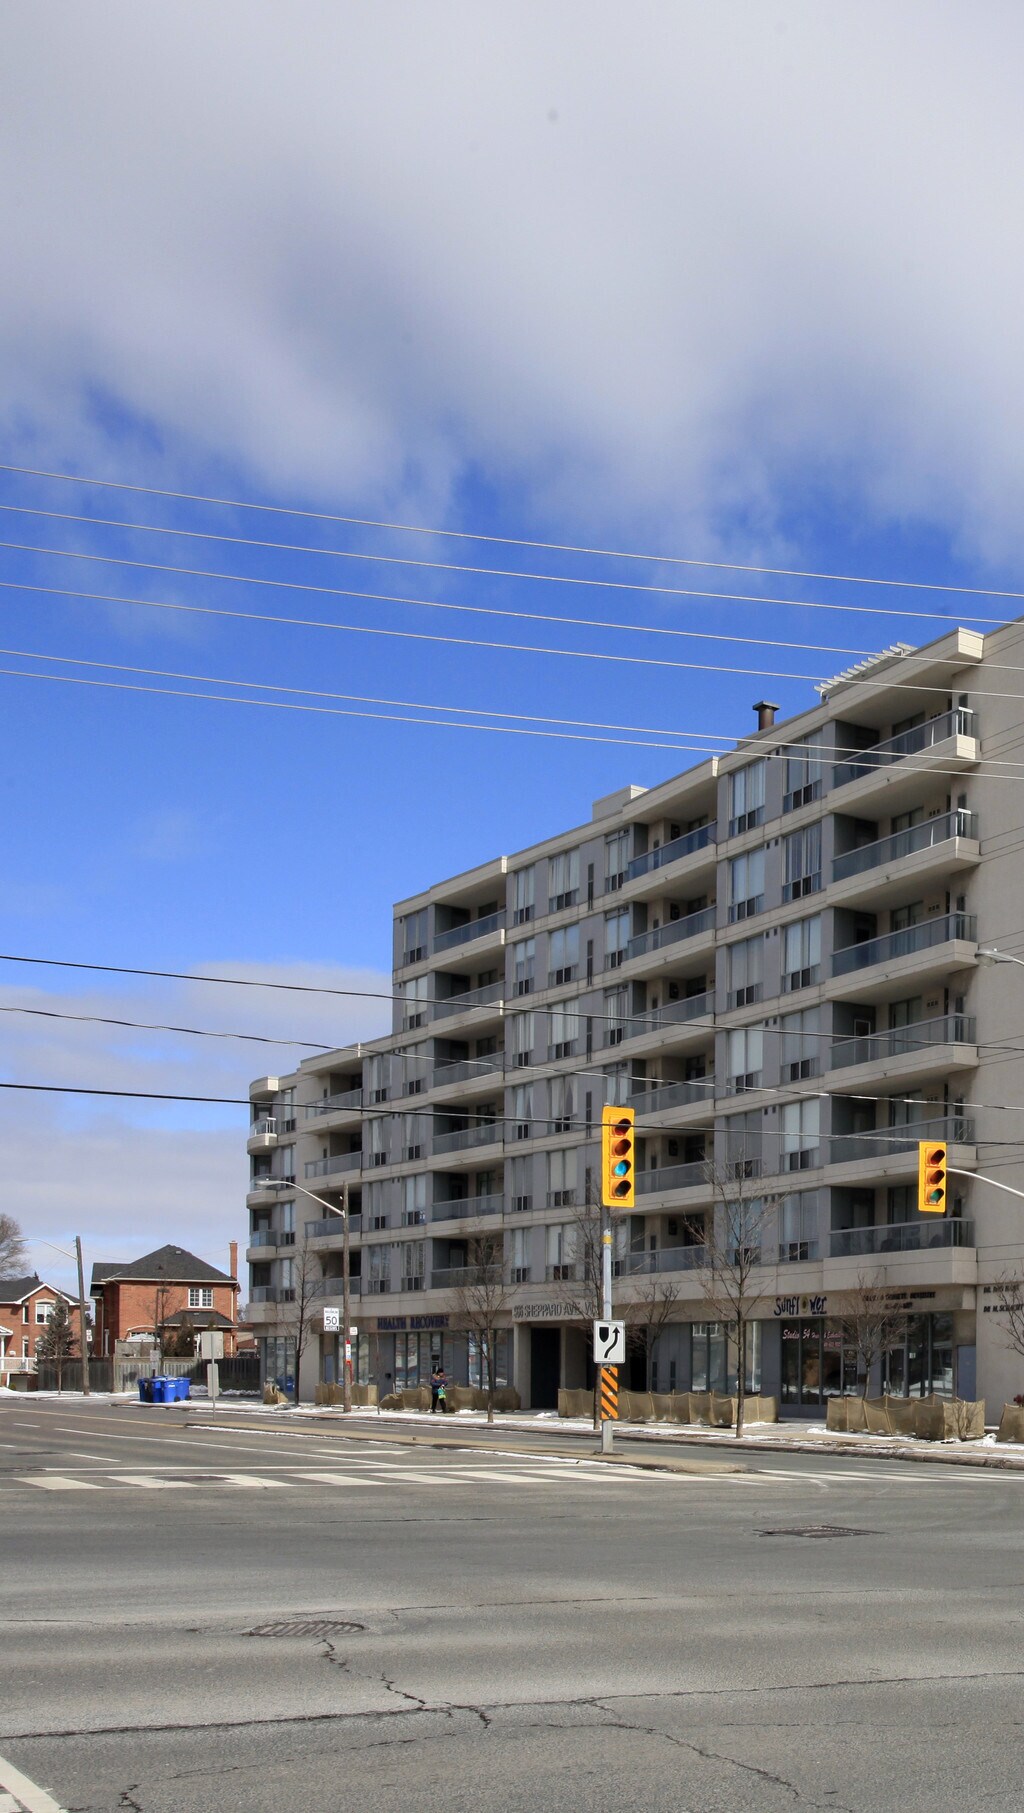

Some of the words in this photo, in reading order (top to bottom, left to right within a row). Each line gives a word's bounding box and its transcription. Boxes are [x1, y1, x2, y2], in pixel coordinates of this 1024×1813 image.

[524, 1303, 562, 1318] SHEPPARD
[326, 1316, 338, 1325] 50
[377, 1316, 407, 1330] HEALTH
[782, 1328, 800, 1340] Studio
